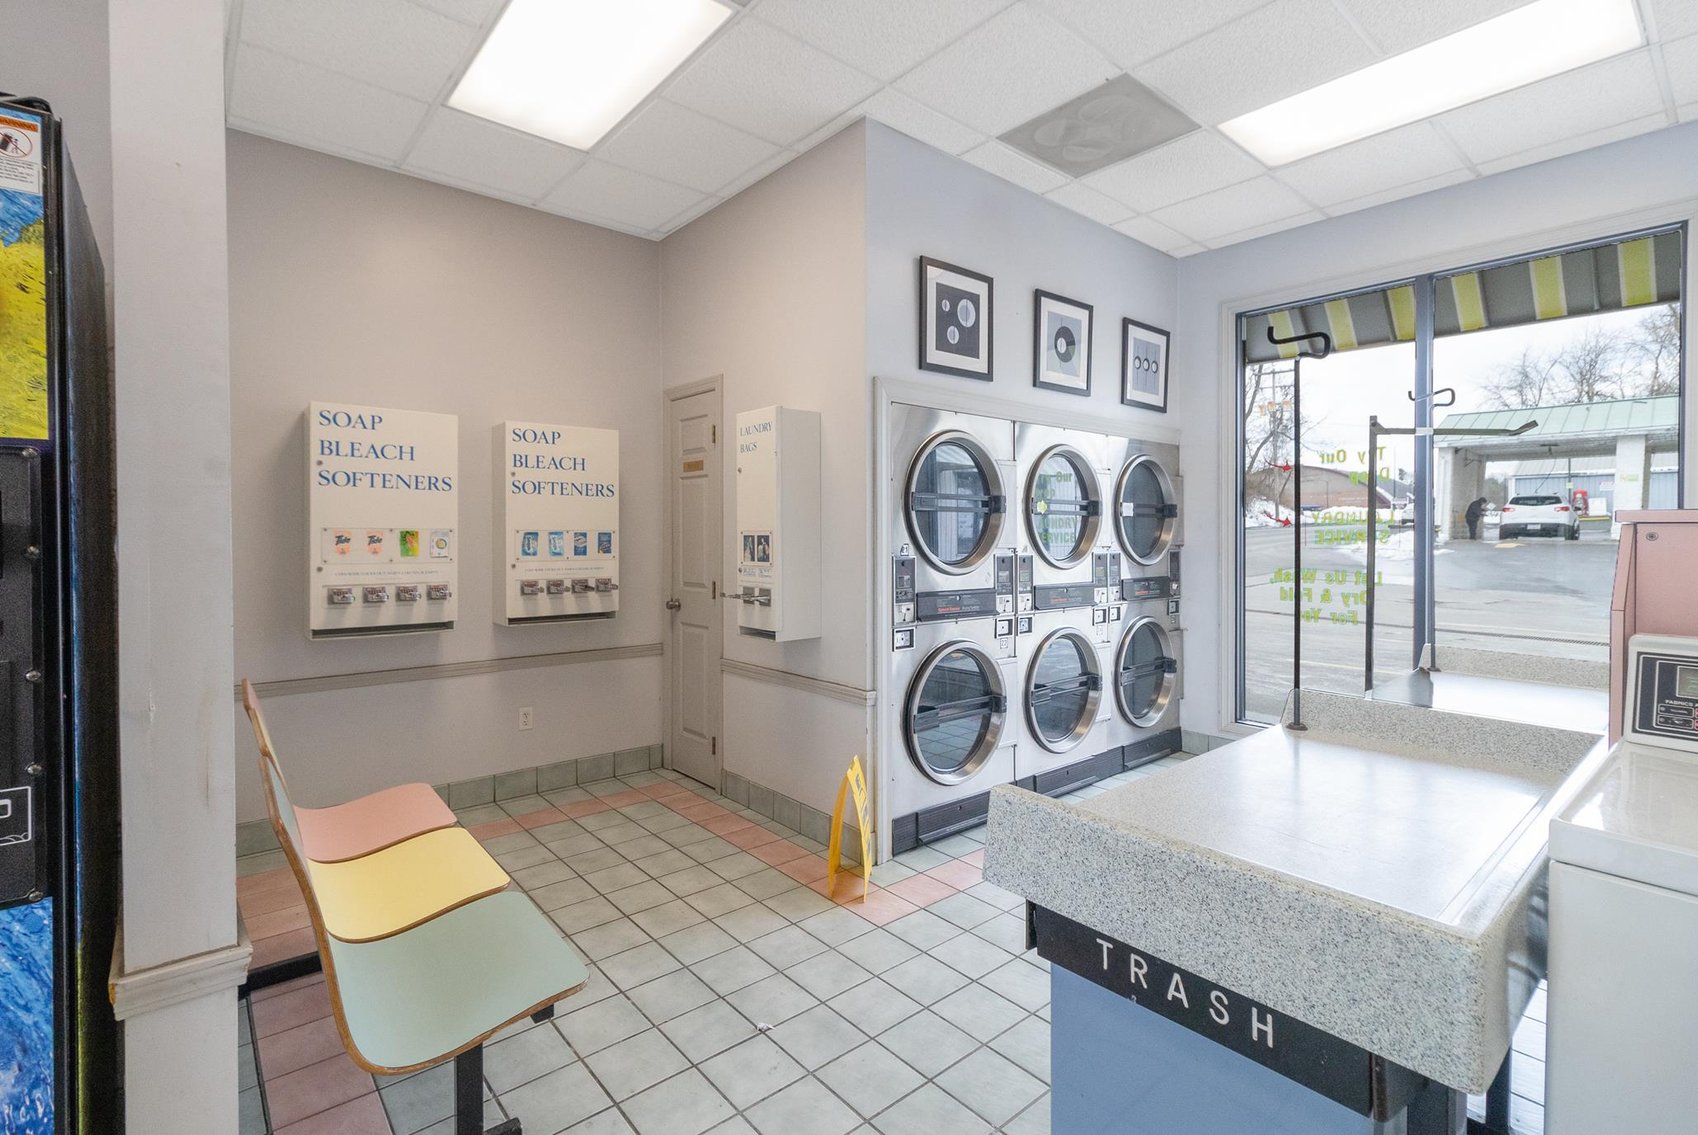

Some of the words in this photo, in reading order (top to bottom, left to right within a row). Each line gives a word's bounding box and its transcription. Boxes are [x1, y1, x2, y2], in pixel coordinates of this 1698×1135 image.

[319, 409, 383, 431] SOAP
[740, 421, 773, 437] LAUNDRY
[512, 428, 561, 445] SOAP
[319, 439, 415, 461] BLEACH
[740, 442, 758, 454] BAGS
[512, 453, 586, 471] BLEACH
[318, 470, 452, 492] SOFTENERS
[511, 479, 615, 498] SOFTENERS
[1096, 938, 1273, 1048] TRASH
